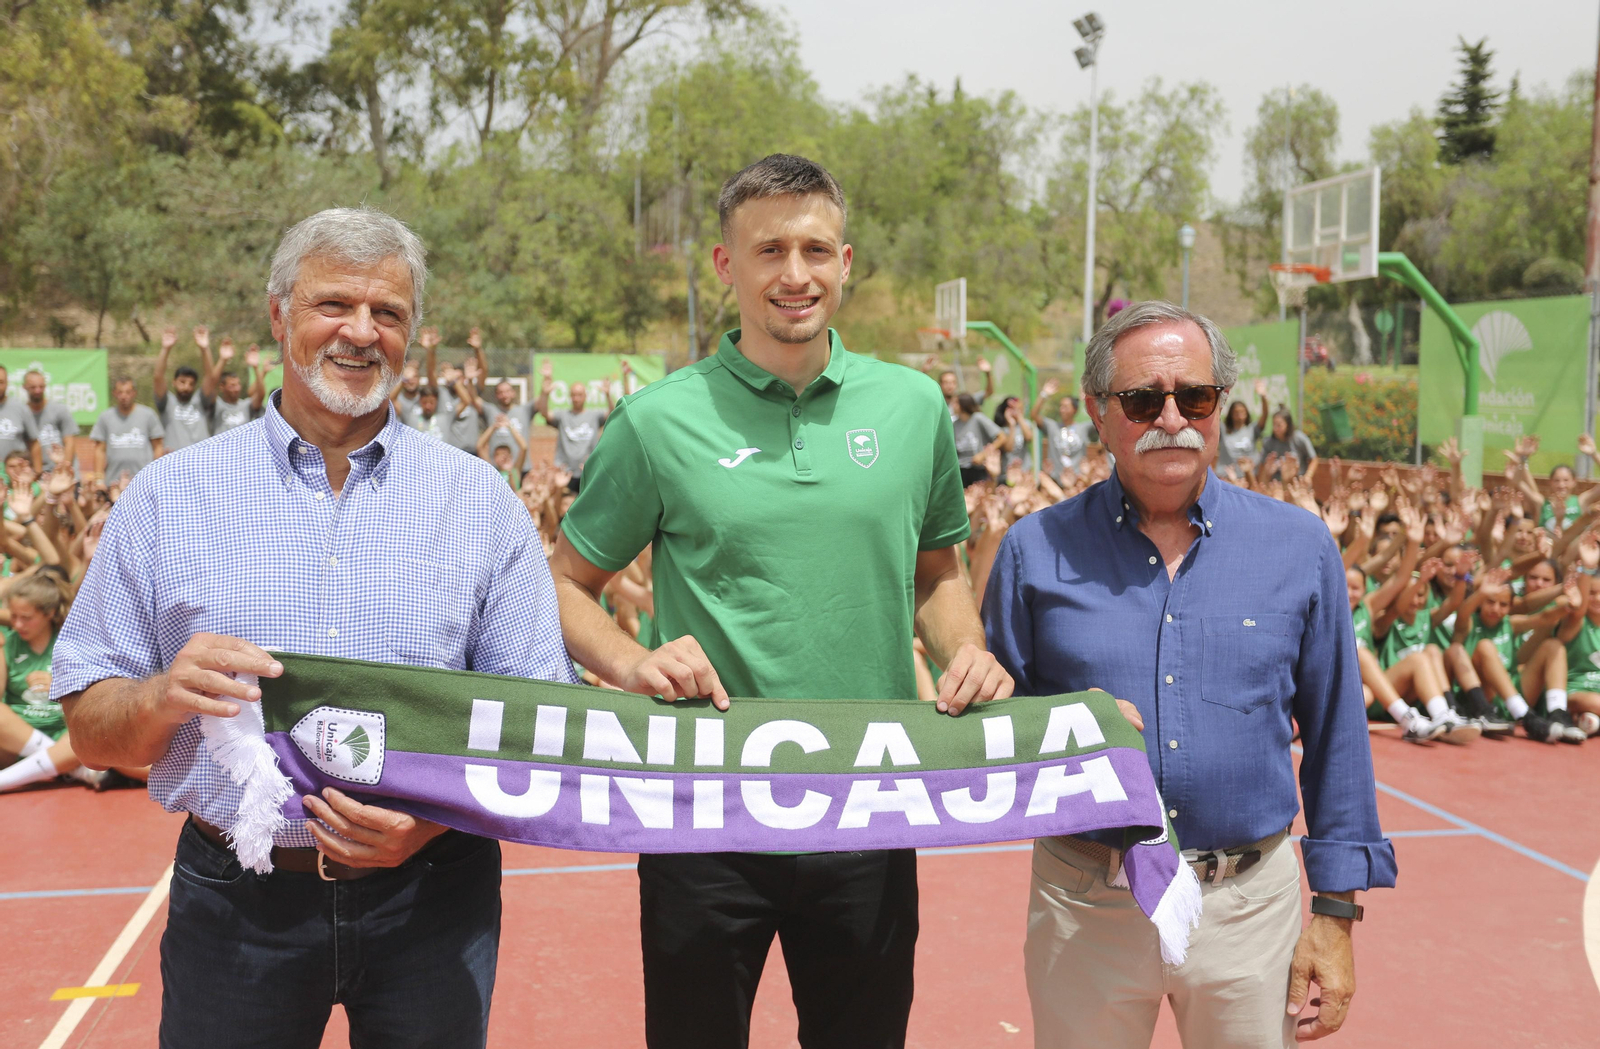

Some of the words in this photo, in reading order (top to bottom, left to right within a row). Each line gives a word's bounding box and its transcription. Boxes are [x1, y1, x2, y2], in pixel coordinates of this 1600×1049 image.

[1478, 387, 1535, 406] ndación
[323, 722, 338, 762] Unicaja
[464, 698, 1129, 830] UNICAJA
